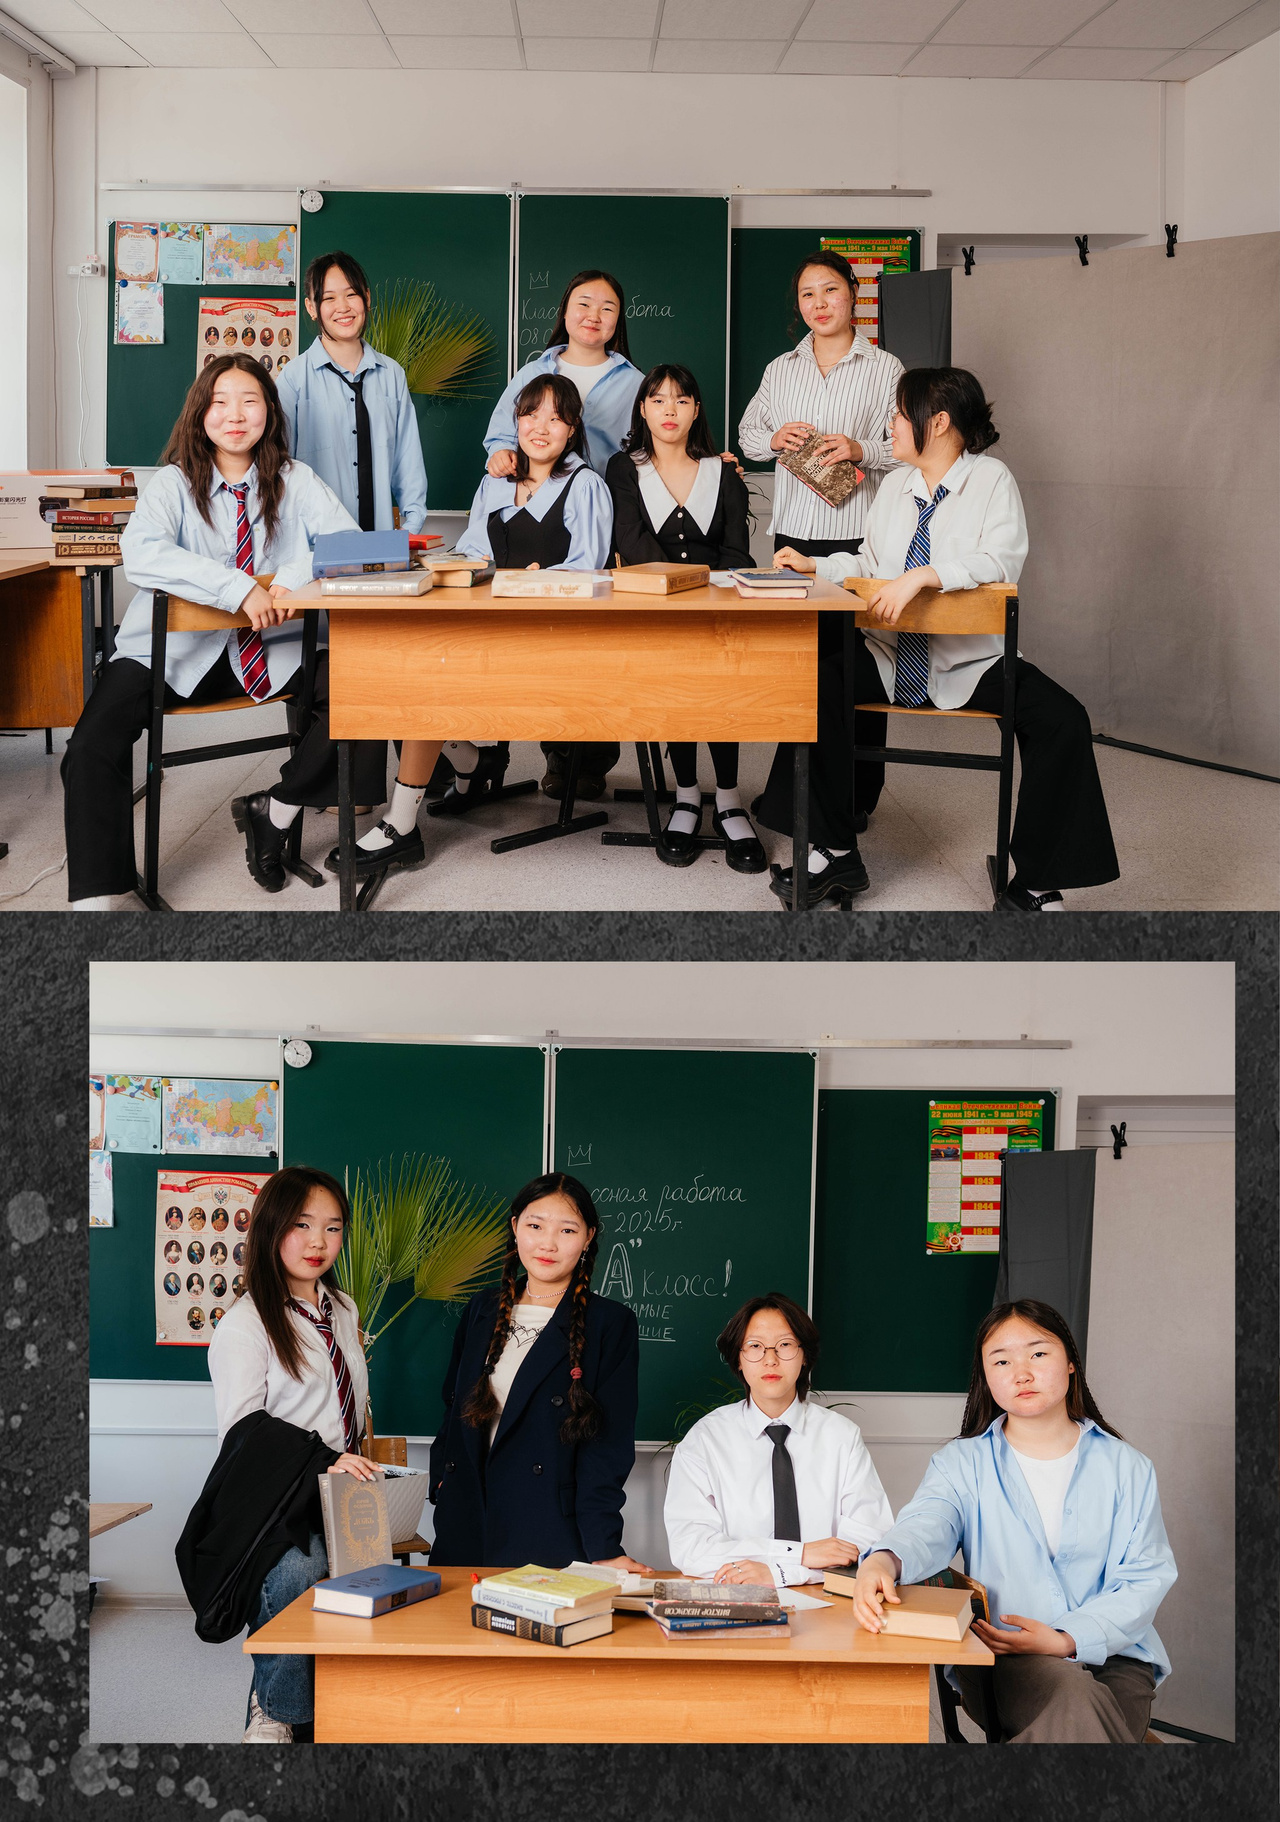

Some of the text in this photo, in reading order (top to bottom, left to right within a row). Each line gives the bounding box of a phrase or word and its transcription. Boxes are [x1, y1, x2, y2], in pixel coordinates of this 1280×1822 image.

[521, 294, 674, 320] Клас бота
[974, 1152, 995, 1160] 1942
[974, 1177, 995, 1185] 1943
[590, 1174, 747, 1224] ссная работа
[973, 1202, 994, 1210] 1944
[973, 1227, 993, 1235] 1945
[664, 1607, 731, 1617] ВИКТОР НЕКРАСОВ
